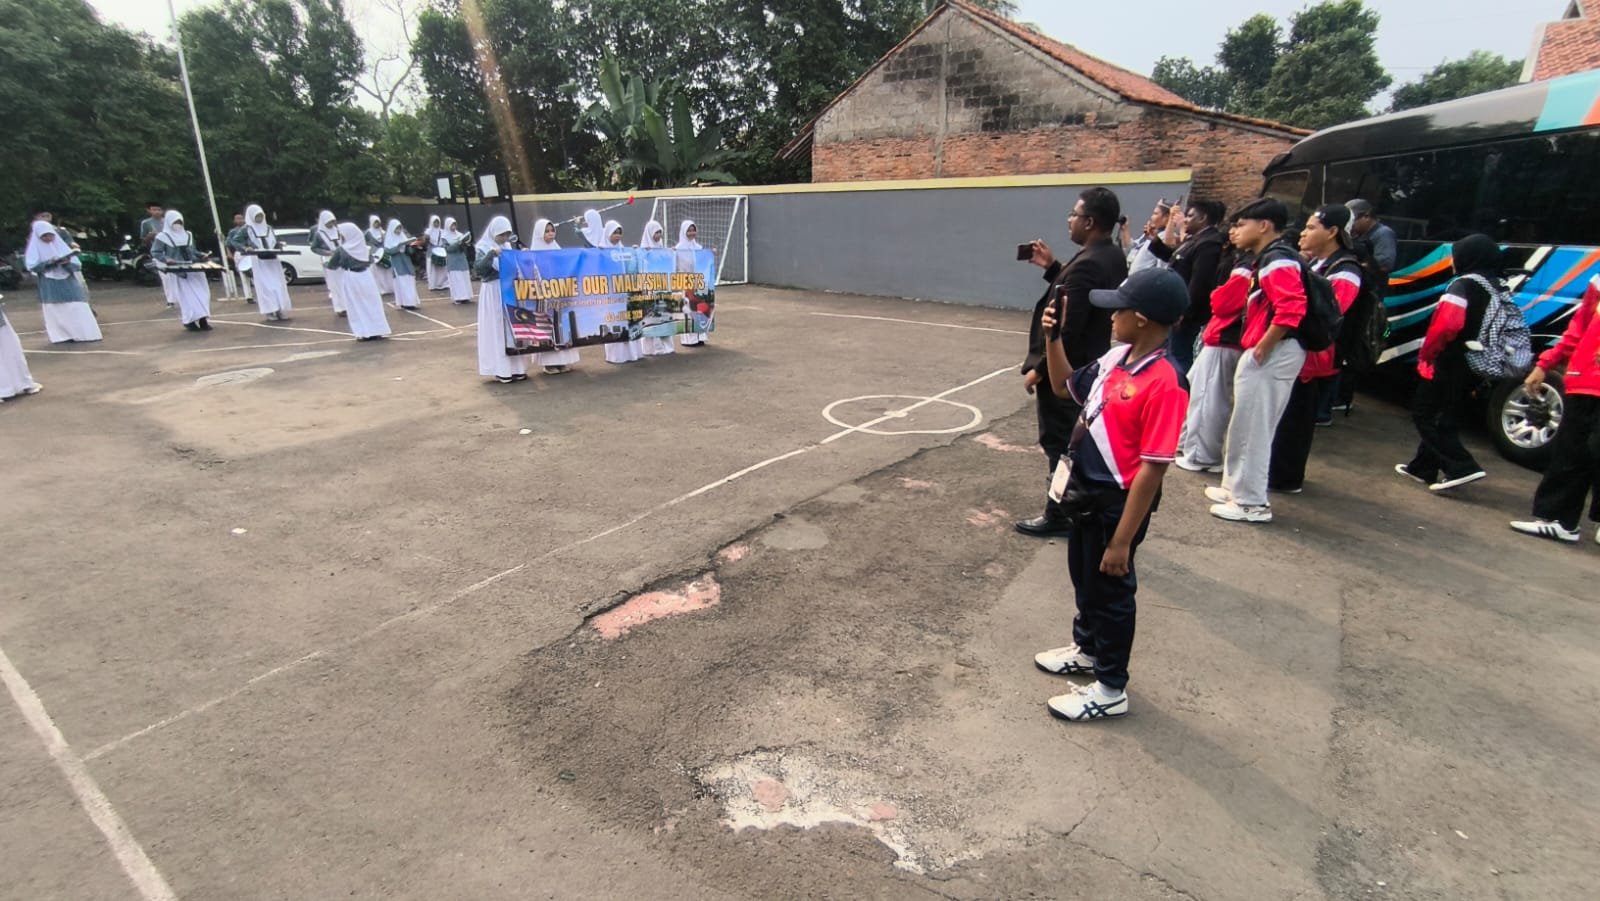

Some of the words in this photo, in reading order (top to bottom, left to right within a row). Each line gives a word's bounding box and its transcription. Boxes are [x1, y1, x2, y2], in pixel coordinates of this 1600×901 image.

[514, 277, 579, 300] WELCOME
[583, 274, 609, 296] OUR
[612, 273, 668, 293] MALAYSIAN
[670, 272, 705, 291] GUESTS
